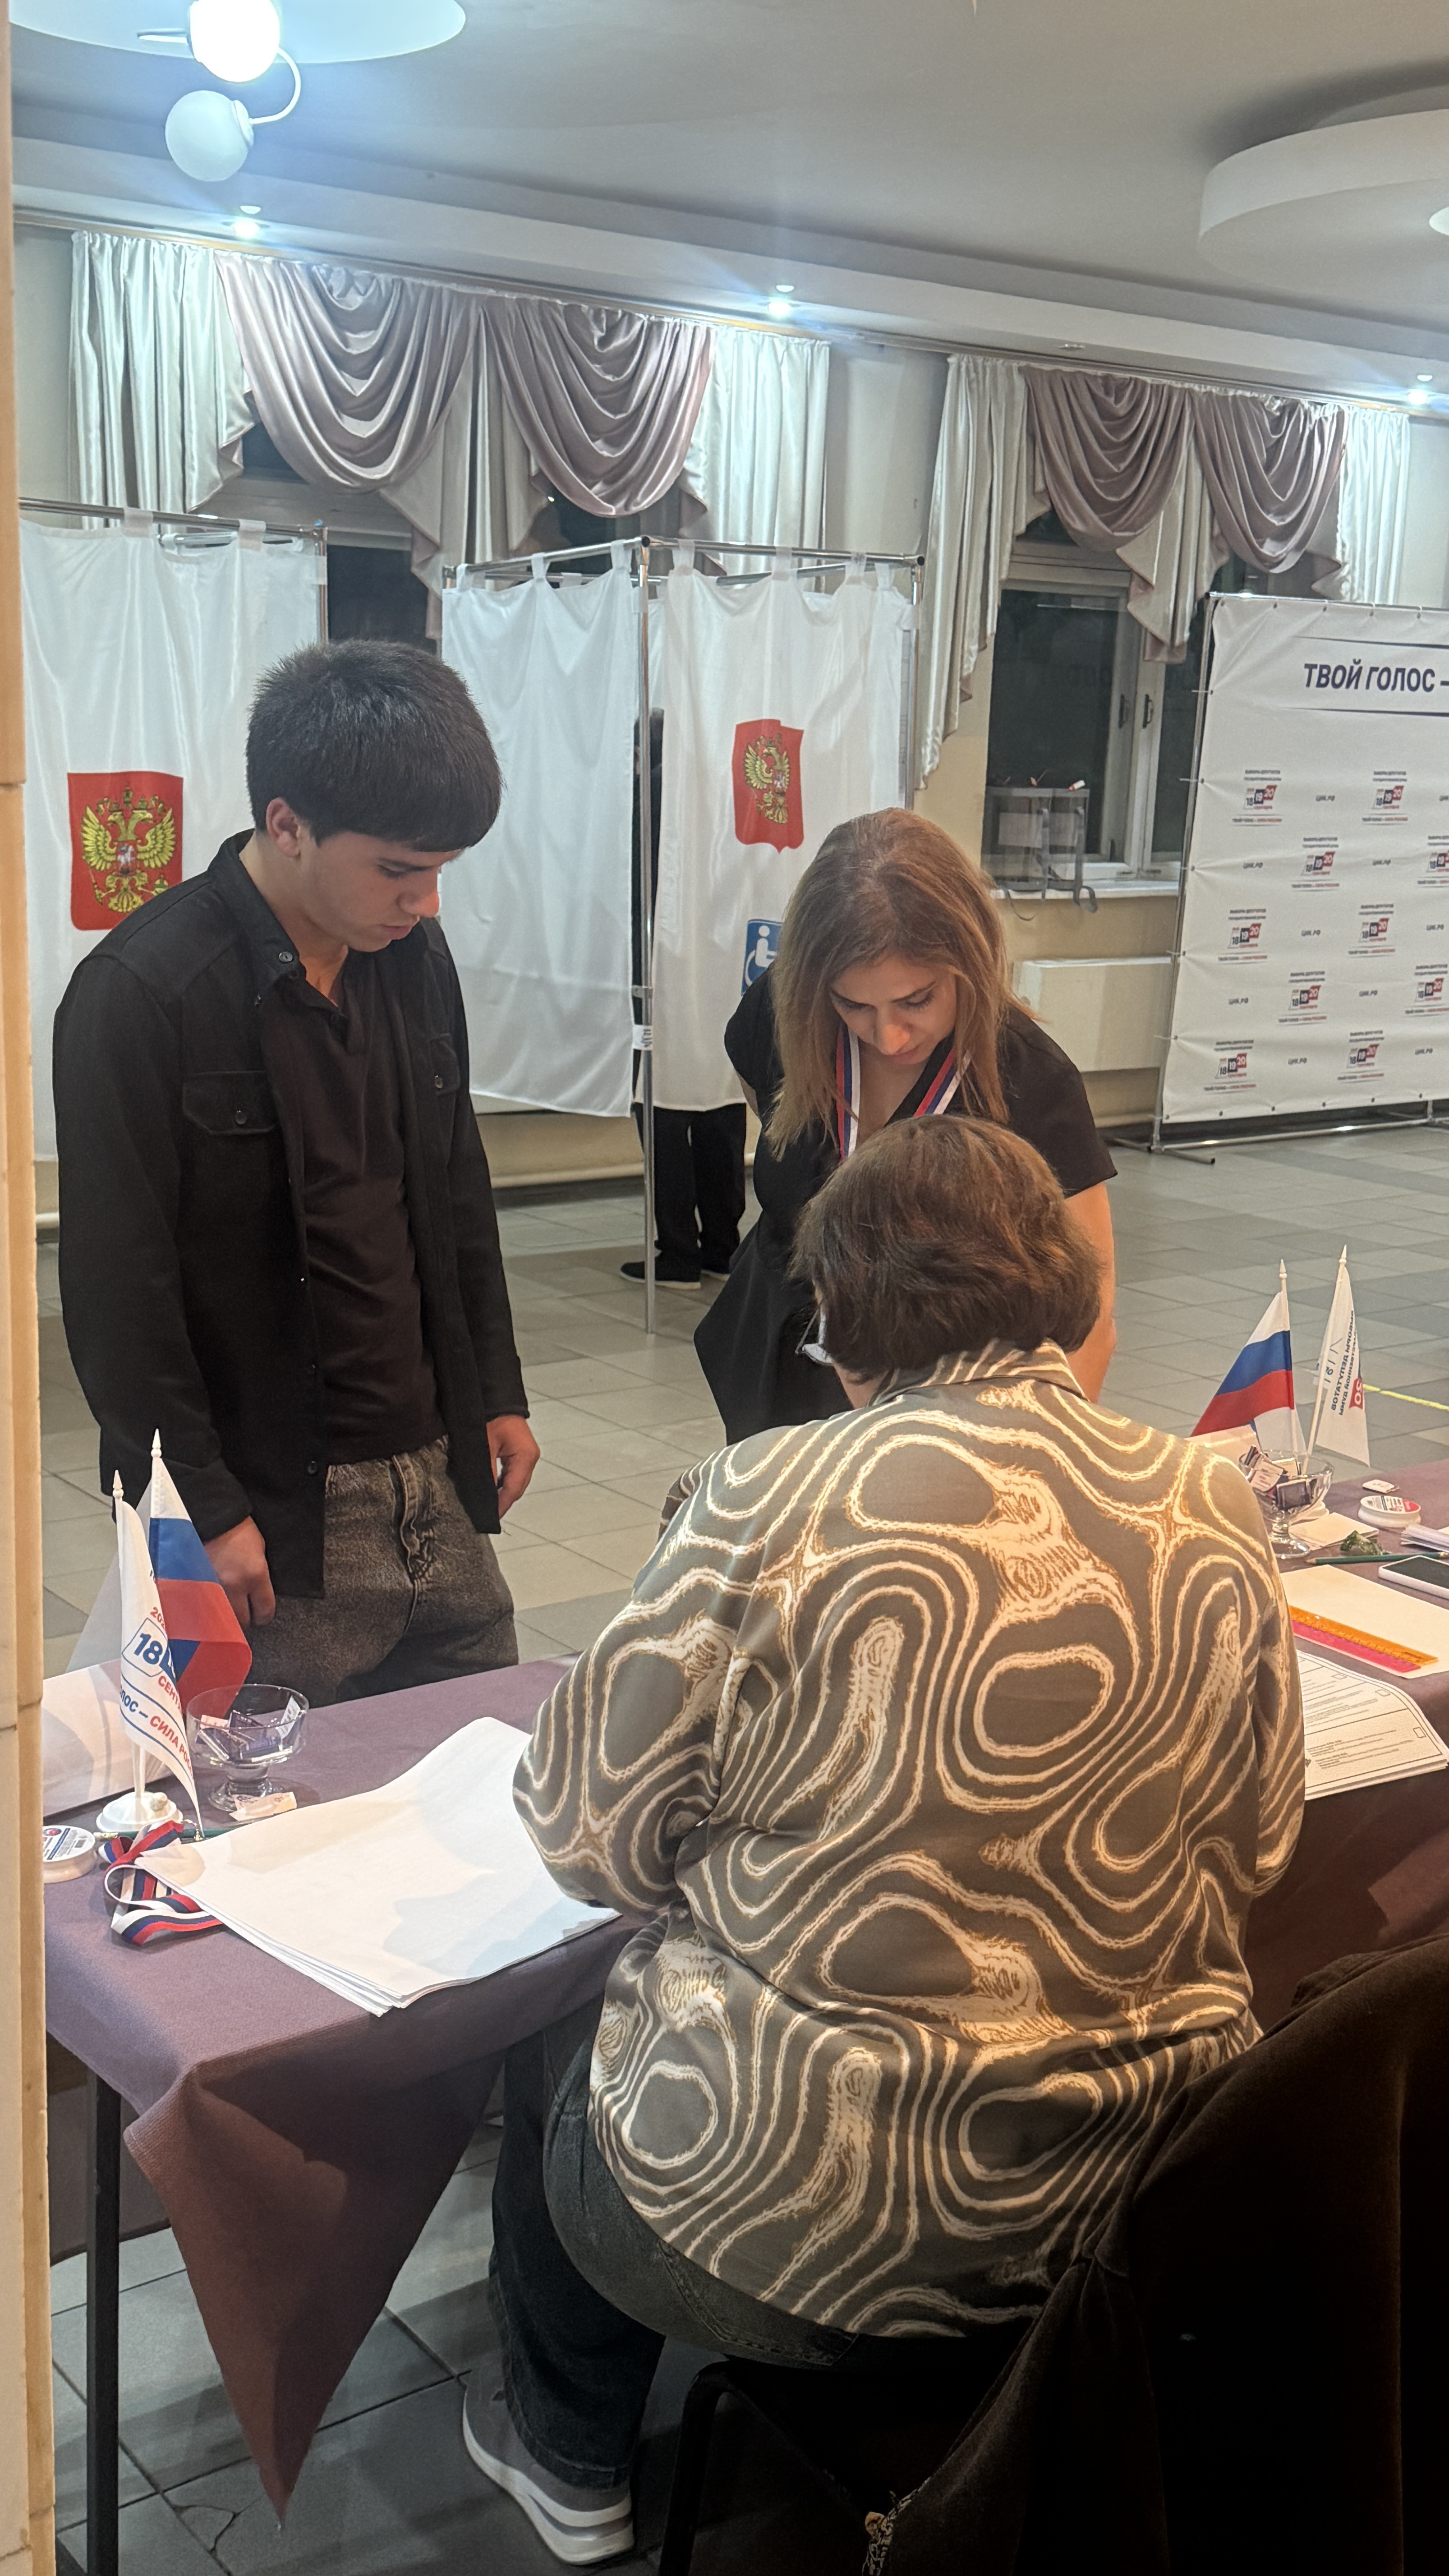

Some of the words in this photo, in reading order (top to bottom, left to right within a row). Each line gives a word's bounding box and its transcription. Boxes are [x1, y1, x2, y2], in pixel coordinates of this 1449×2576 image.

[1304, 658, 1363, 690] ТВОЙ
[1366, 667, 1435, 692] ГОЛОС
[134, 1633, 163, 1665] 18
[150, 1716, 178, 1748] СИЛА
